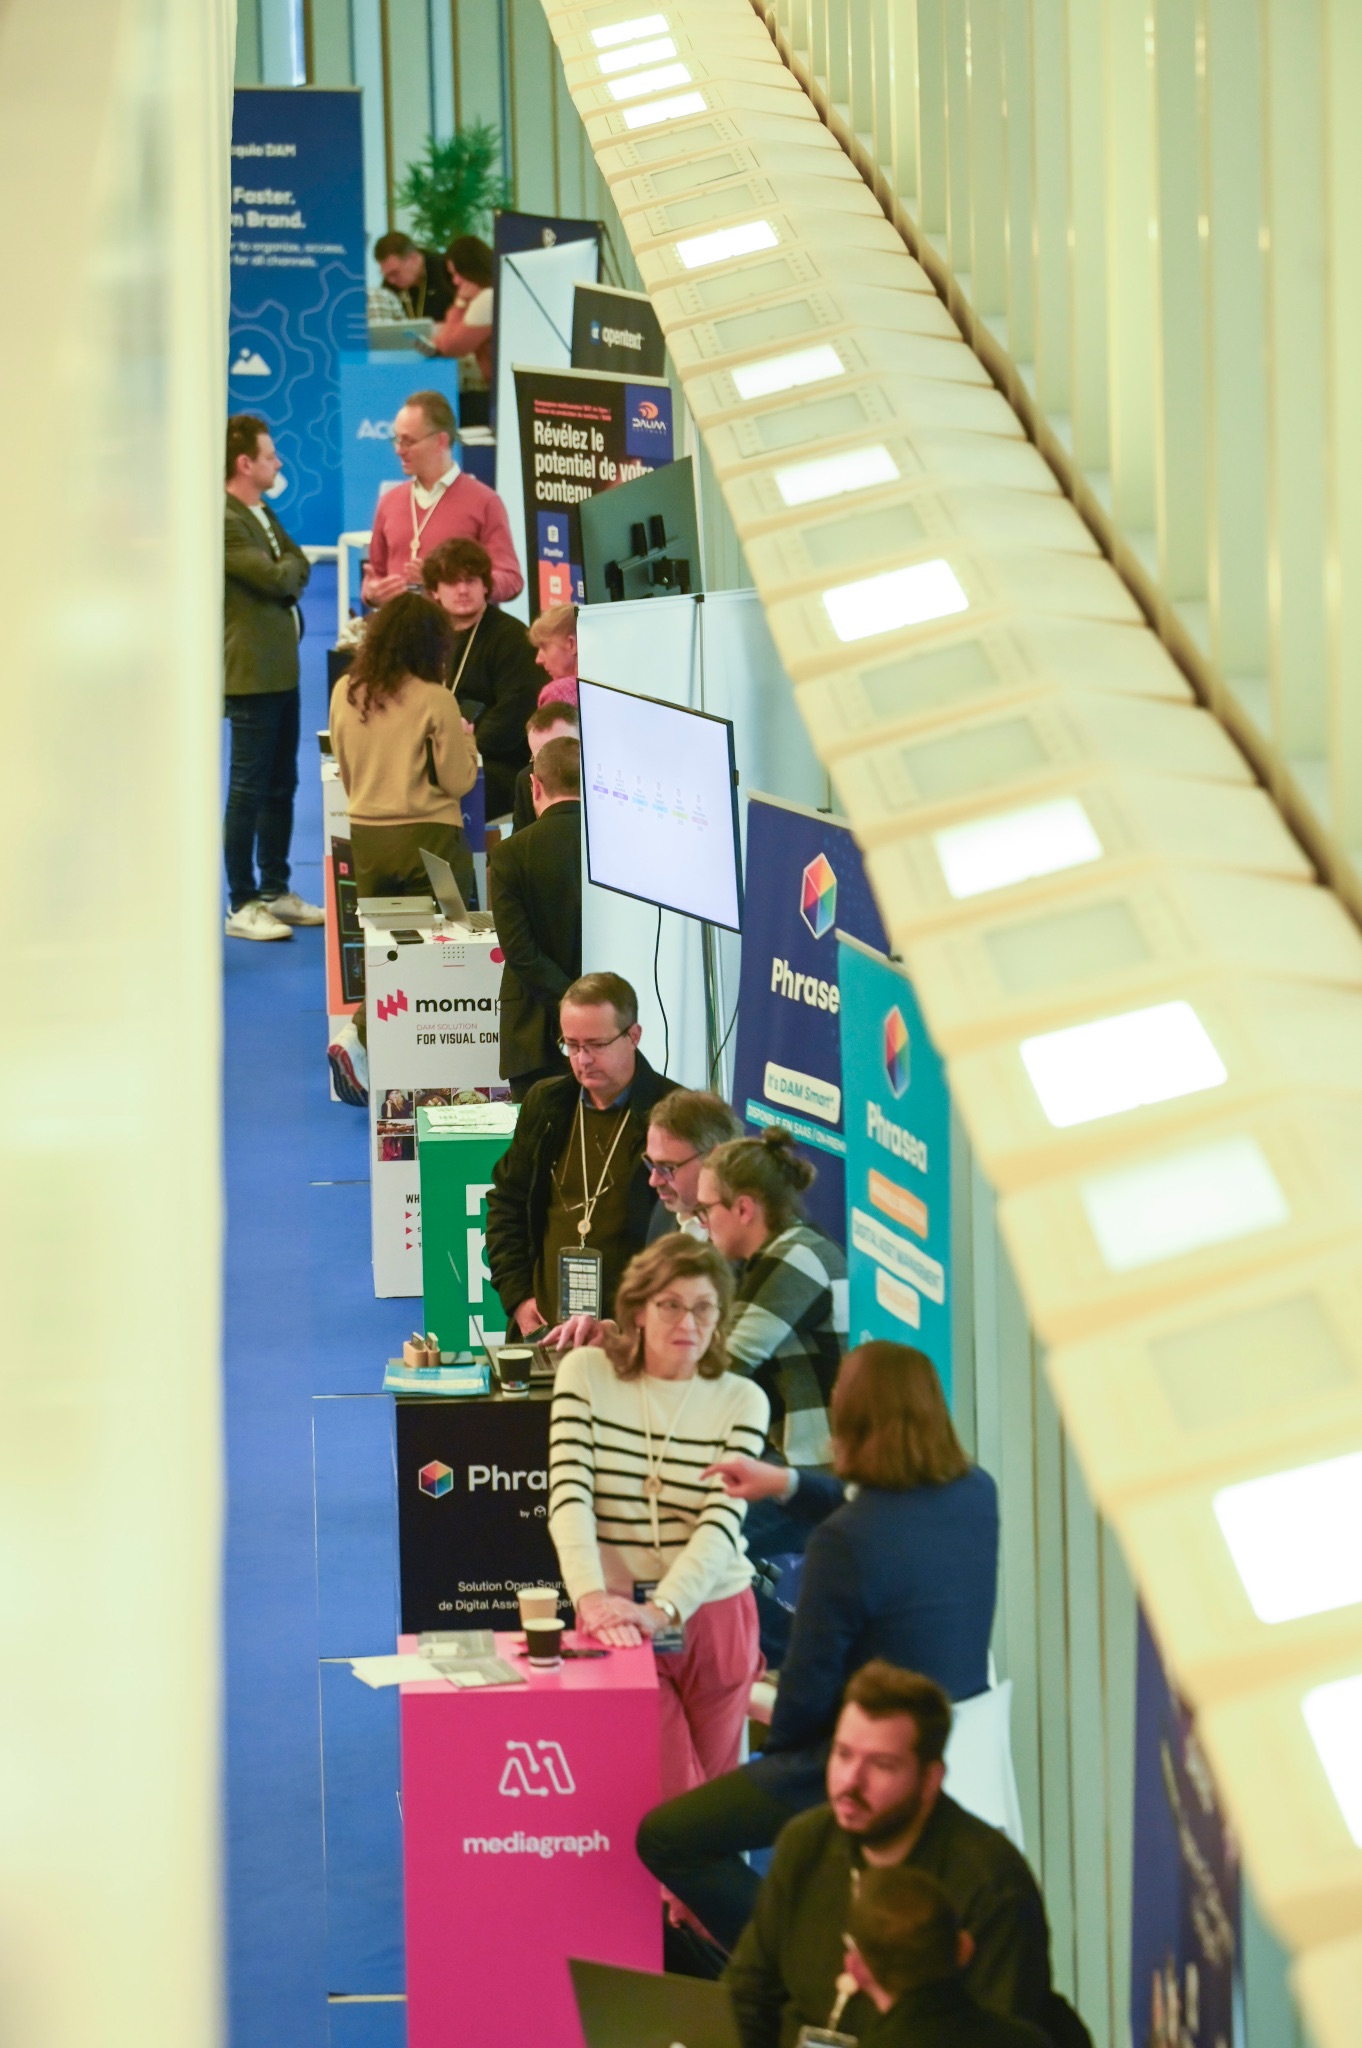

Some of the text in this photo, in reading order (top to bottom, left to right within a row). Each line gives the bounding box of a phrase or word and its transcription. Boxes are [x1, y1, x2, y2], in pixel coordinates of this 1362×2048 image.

[265, 143, 296, 157] DAM
[233, 186, 296, 205] Faster.
[246, 210, 306, 228] Brand.
[602, 327, 641, 350] opentext
[533, 420, 604, 452] Révélez le
[535, 451, 655, 483] potentiel de vot
[535, 479, 592, 504] contenu
[771, 957, 840, 1014] Phrase
[416, 1034, 436, 1044] FOR
[439, 1033, 476, 1044] VISUAL
[780, 1078, 803, 1098] DAM
[468, 1465, 548, 1492] Phra
[520, 1509, 530, 1518] by
[458, 1580, 502, 1592] Solution
[504, 1580, 534, 1591] Open
[438, 1600, 453, 1611] de
[455, 1599, 489, 1612] Digital
[463, 1829, 610, 1858] mediagraph
